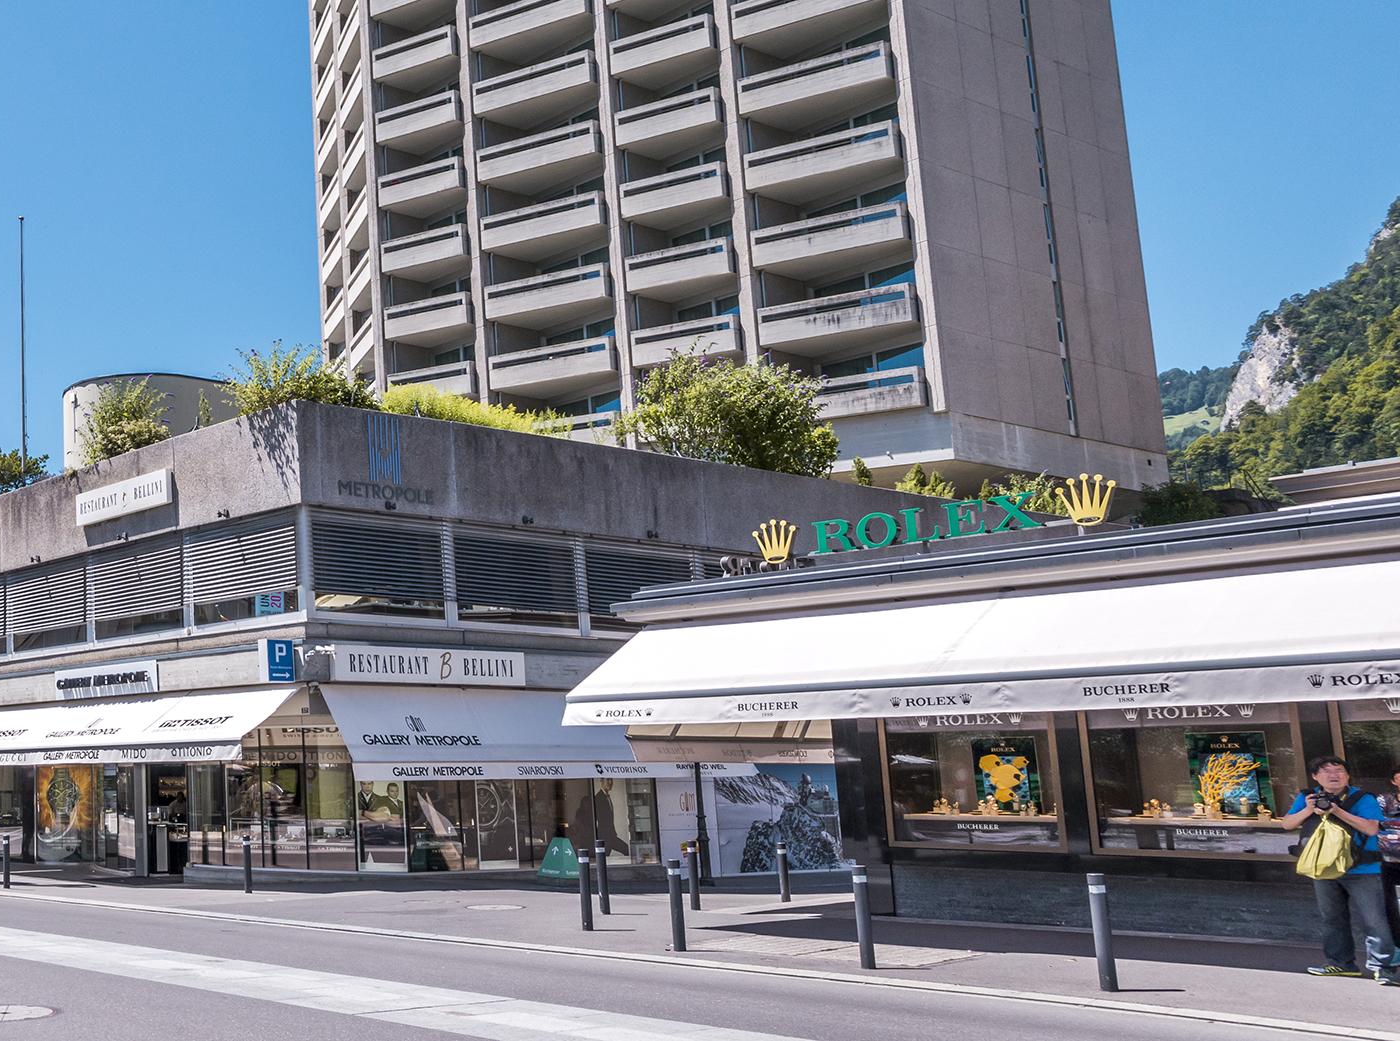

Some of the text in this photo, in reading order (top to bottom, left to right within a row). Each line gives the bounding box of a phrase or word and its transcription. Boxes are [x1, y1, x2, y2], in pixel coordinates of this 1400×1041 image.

[80, 480, 163, 515] RESTAURANT BELLINI
[338, 479, 435, 505] METROPOLE
[811, 491, 1043, 554] ROLEX
[275, 643, 287, 663] P
[349, 653, 429, 675] RESTAURANT
[463, 658, 514, 678] BELLINI
[1083, 682, 1171, 697] BUCHERER
[737, 701, 799, 712] BUCHERER
[905, 695, 957, 707] ROLEX
[605, 709, 642, 718] ROLEX
[1146, 705, 1231, 720] ROLEX
[935, 713, 1003, 727] ROLEX
[362, 734, 482, 746] GALLERY METROPOLE
[0, 753, 27, 762] GUCCI
[43, 750, 100, 761] GALLERY METROPOLE
[121, 748, 147, 759] MIDO
[392, 766, 484, 776] GALLERY METROPOLE
[517, 766, 564, 775] SWAROVSKI
[1175, 828, 1229, 836] BUCHERER
